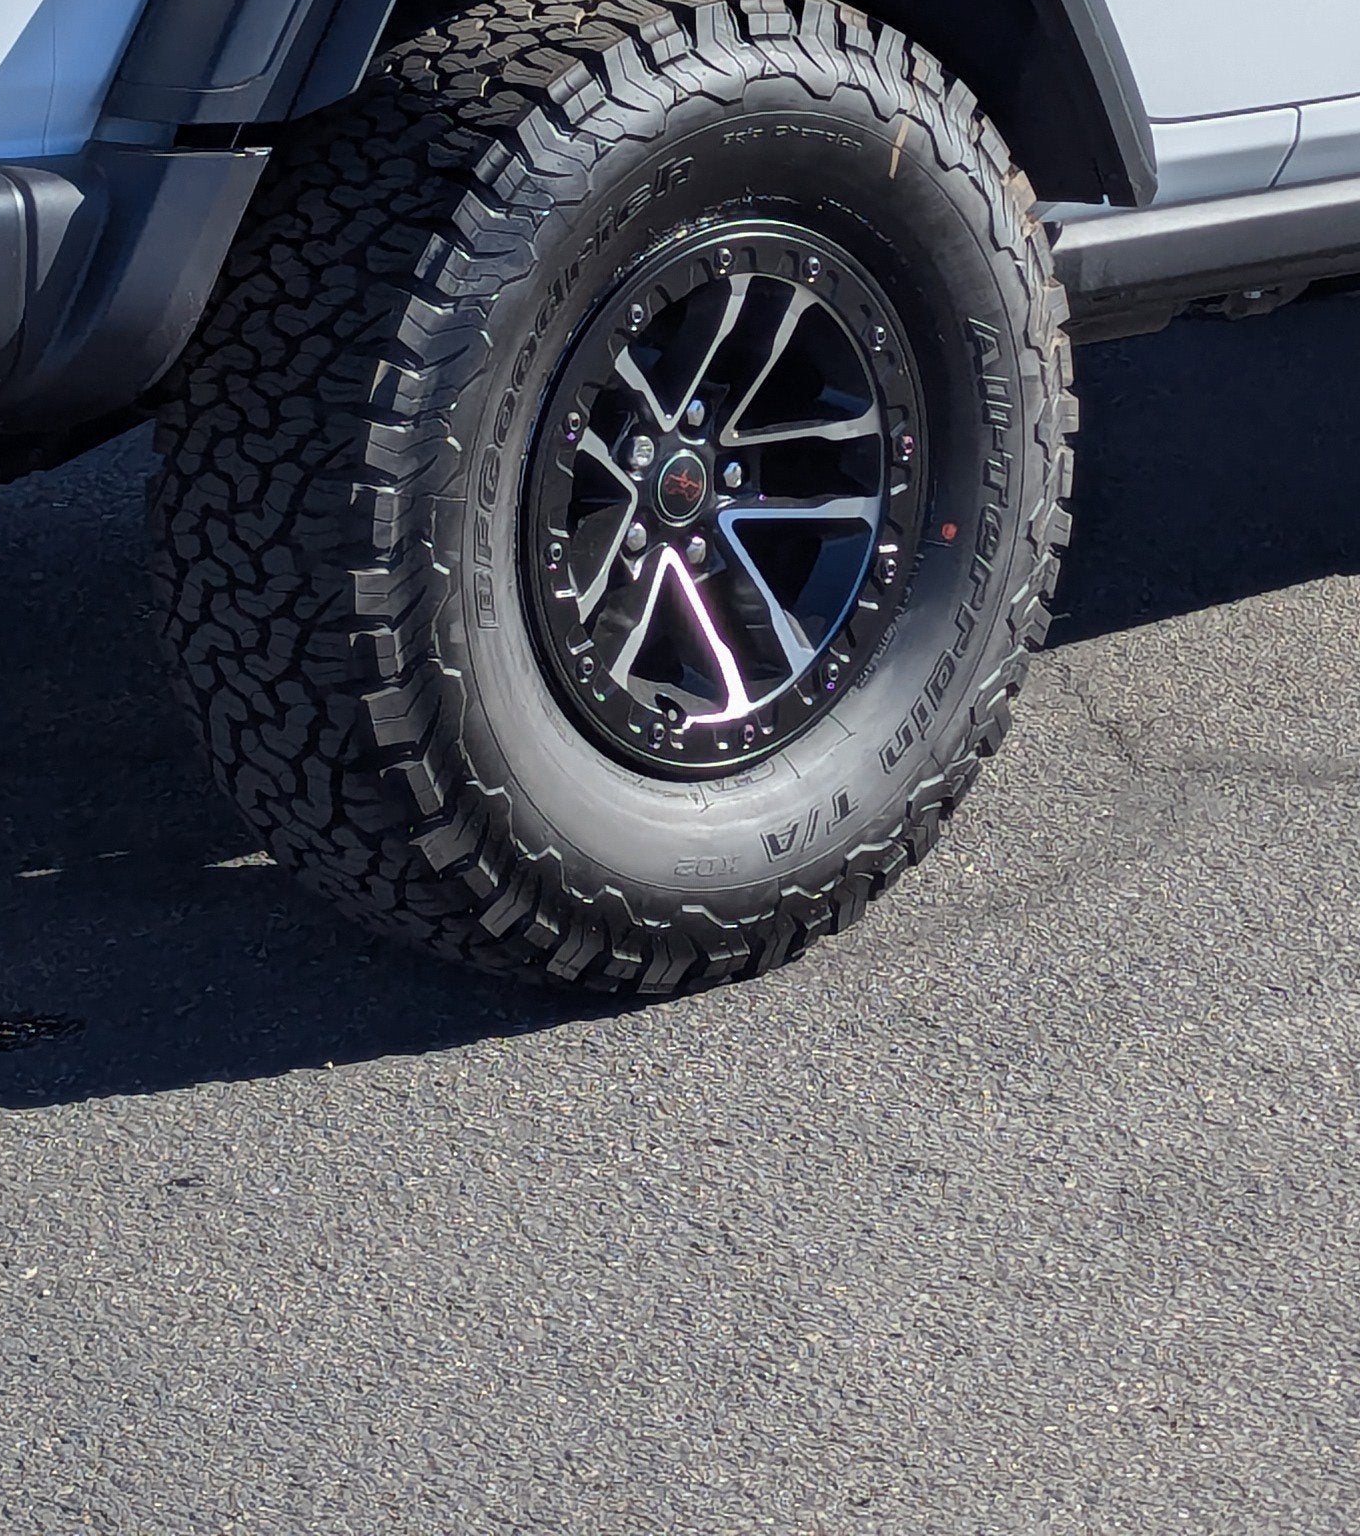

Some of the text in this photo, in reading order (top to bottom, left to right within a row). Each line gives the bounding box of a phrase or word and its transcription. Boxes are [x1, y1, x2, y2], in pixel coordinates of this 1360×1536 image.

[473, 154, 695, 630] BFGoodrich
[879, 315, 1014, 776] All-Terrain
[759, 786, 859, 863] T/A
